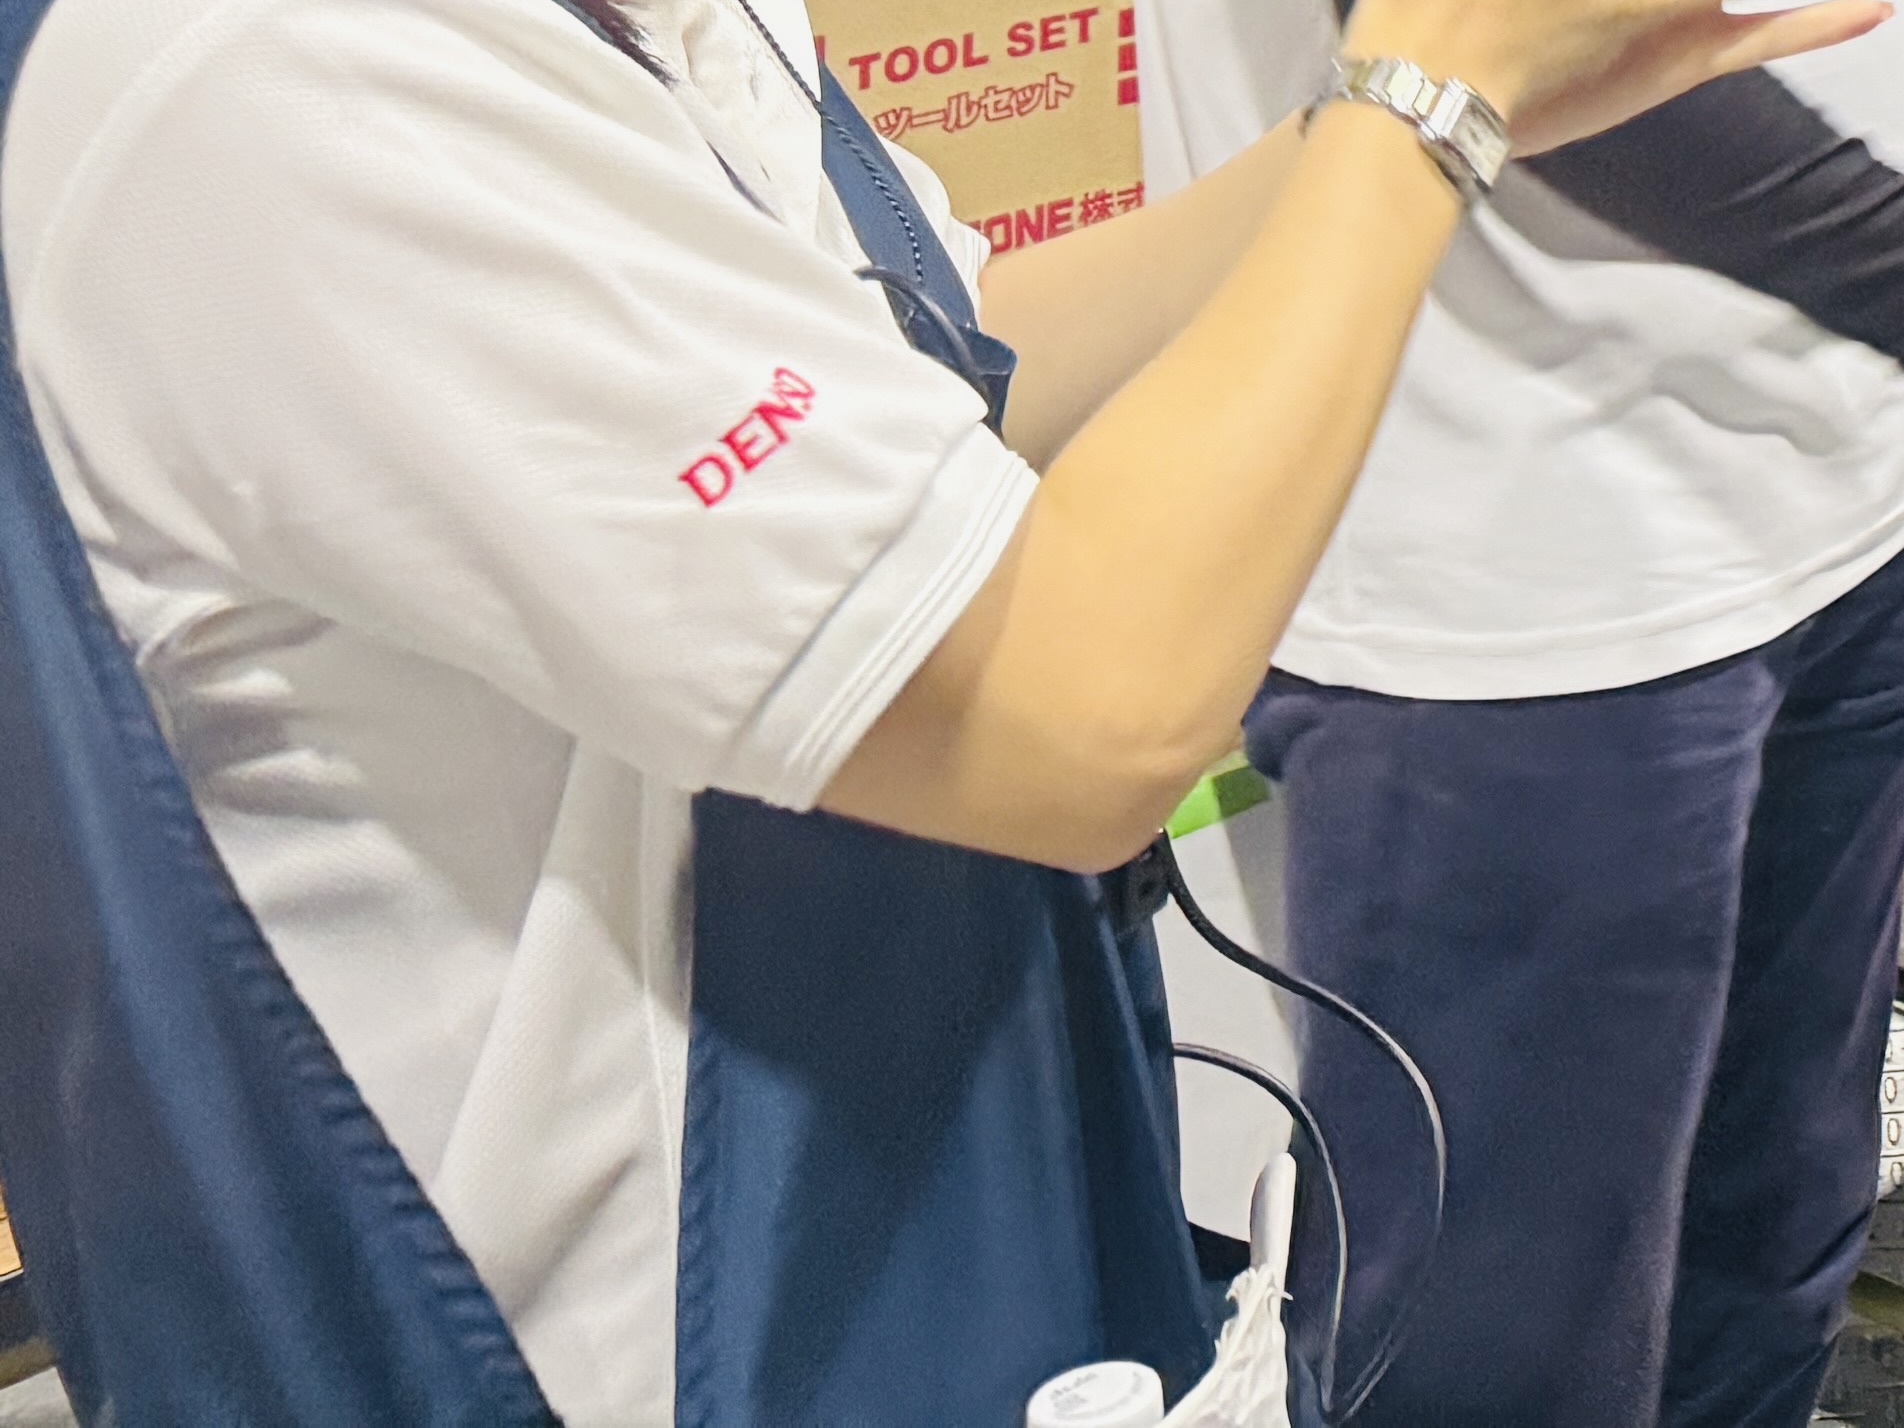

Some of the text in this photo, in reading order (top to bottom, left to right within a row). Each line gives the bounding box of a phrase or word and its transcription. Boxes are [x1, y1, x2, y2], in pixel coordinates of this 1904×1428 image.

[849, 6, 1101, 91] TOOL SET
[873, 72, 1076, 142] ツールセット
